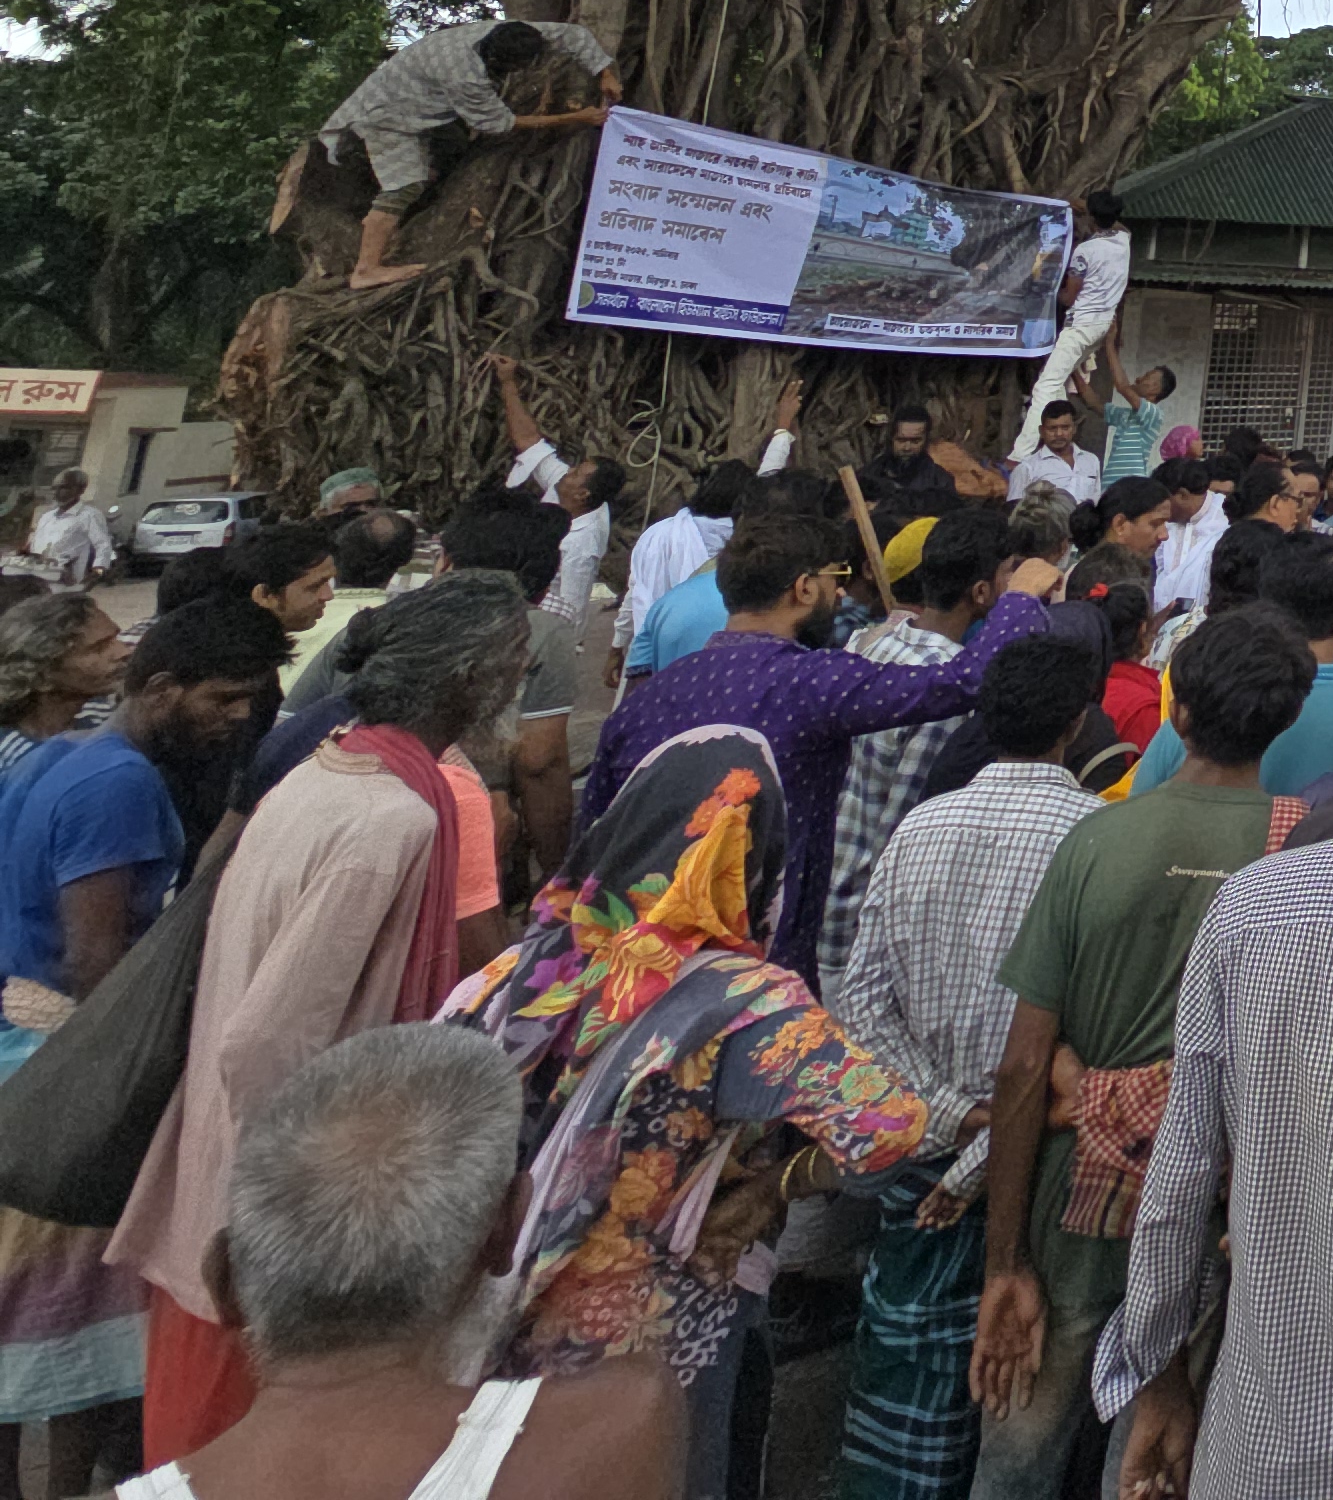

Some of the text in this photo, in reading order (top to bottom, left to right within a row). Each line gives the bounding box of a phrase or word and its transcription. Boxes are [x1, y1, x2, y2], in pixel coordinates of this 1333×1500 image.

[617, 155, 640, 170] এবং
[608, 179, 773, 224] সংবাদ সম্মেলন এবং
[599, 207, 727, 244] প্রতিবাদ সমাবেশ
[637, 297, 676, 314] বাংলাদেশ
[22, 380, 86, 405] রুম
